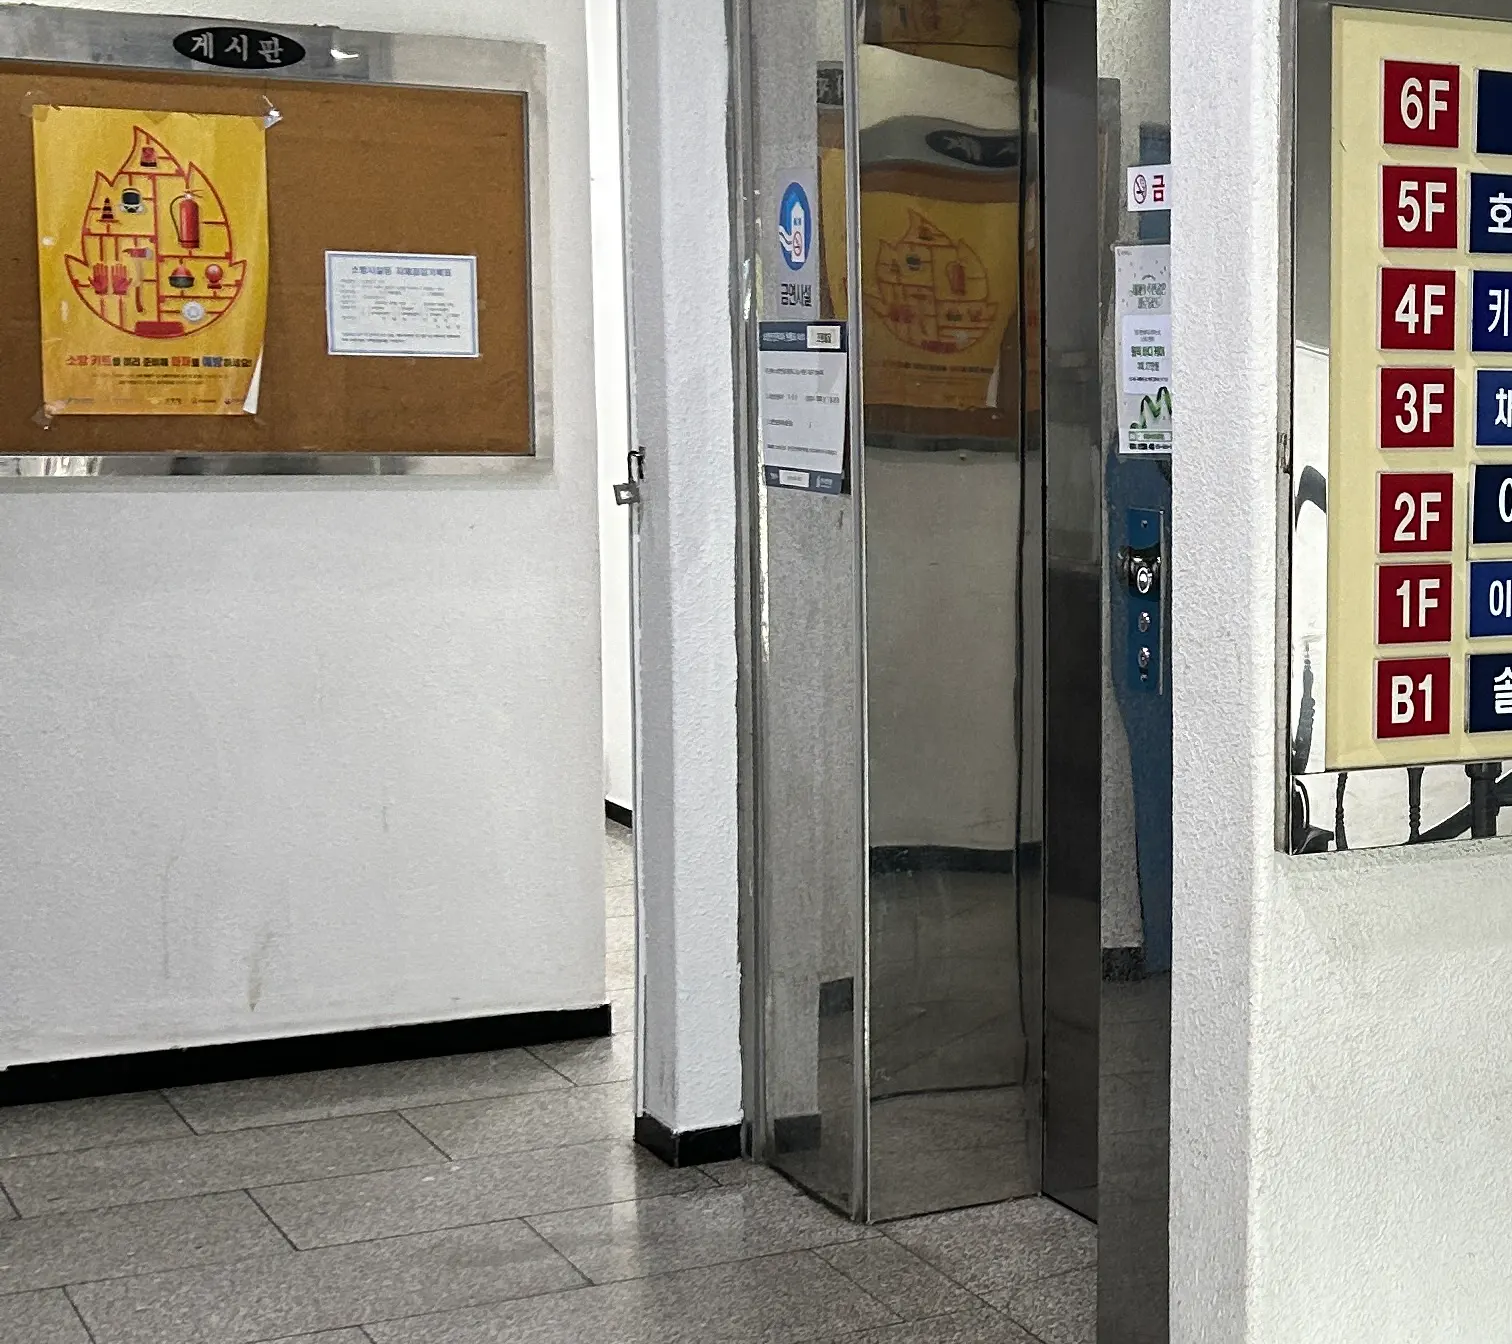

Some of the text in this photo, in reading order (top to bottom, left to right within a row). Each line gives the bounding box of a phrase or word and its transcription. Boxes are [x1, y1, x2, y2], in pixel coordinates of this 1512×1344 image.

[190, 31, 284, 64] 게시판
[1401, 78, 1450, 130] 6F
[1397, 181, 1447, 232] 5F
[780, 283, 812, 307] 금연시설
[1394, 284, 1446, 335] 4F
[1395, 383, 1445, 434] 3F
[1393, 491, 1442, 542] 2F
[1396, 578, 1441, 628] 1F
[1391, 673, 1434, 724] B1
